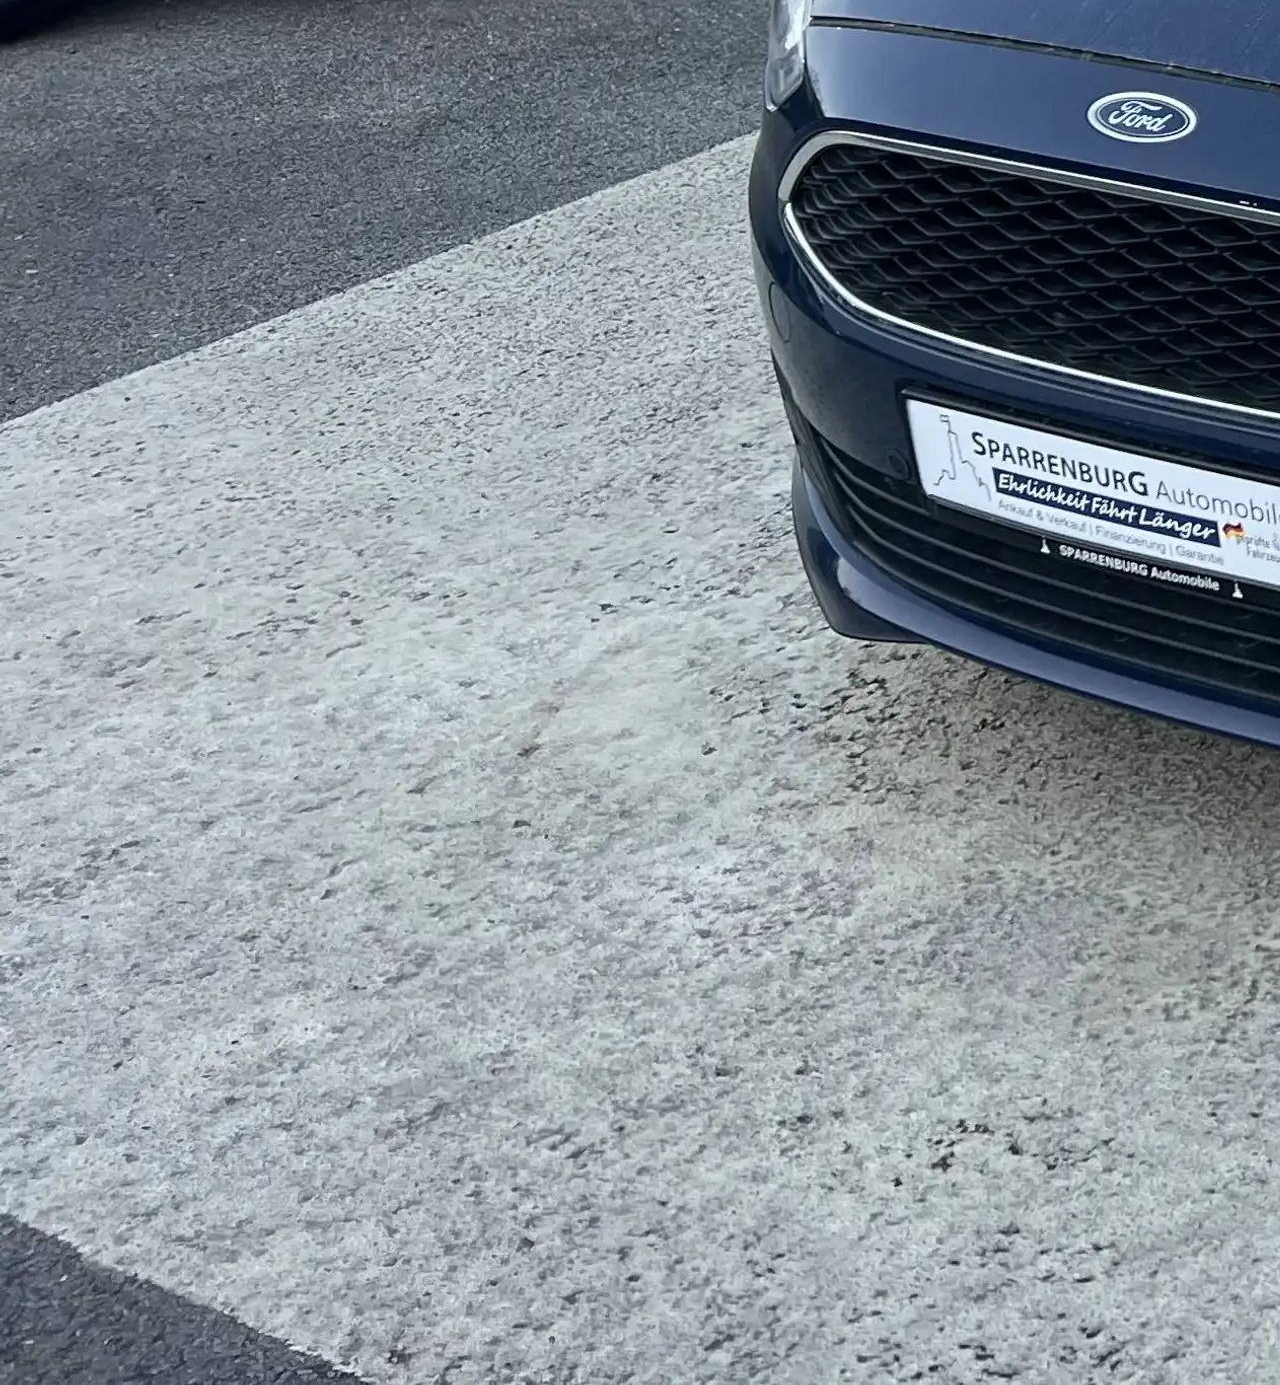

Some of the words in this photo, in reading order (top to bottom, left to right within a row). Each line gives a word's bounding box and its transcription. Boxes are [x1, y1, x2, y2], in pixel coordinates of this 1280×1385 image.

[1108, 100, 1173, 132] Ford
[971, 431, 1148, 496] SPARRENBURG
[998, 473, 1090, 511] Ehrlichkeit
[1091, 497, 1138, 525] Fährt
[1139, 507, 1216, 540] Länger
[1059, 544, 1148, 576] SPARRENBURG
[1150, 566, 1220, 591] Automobile
